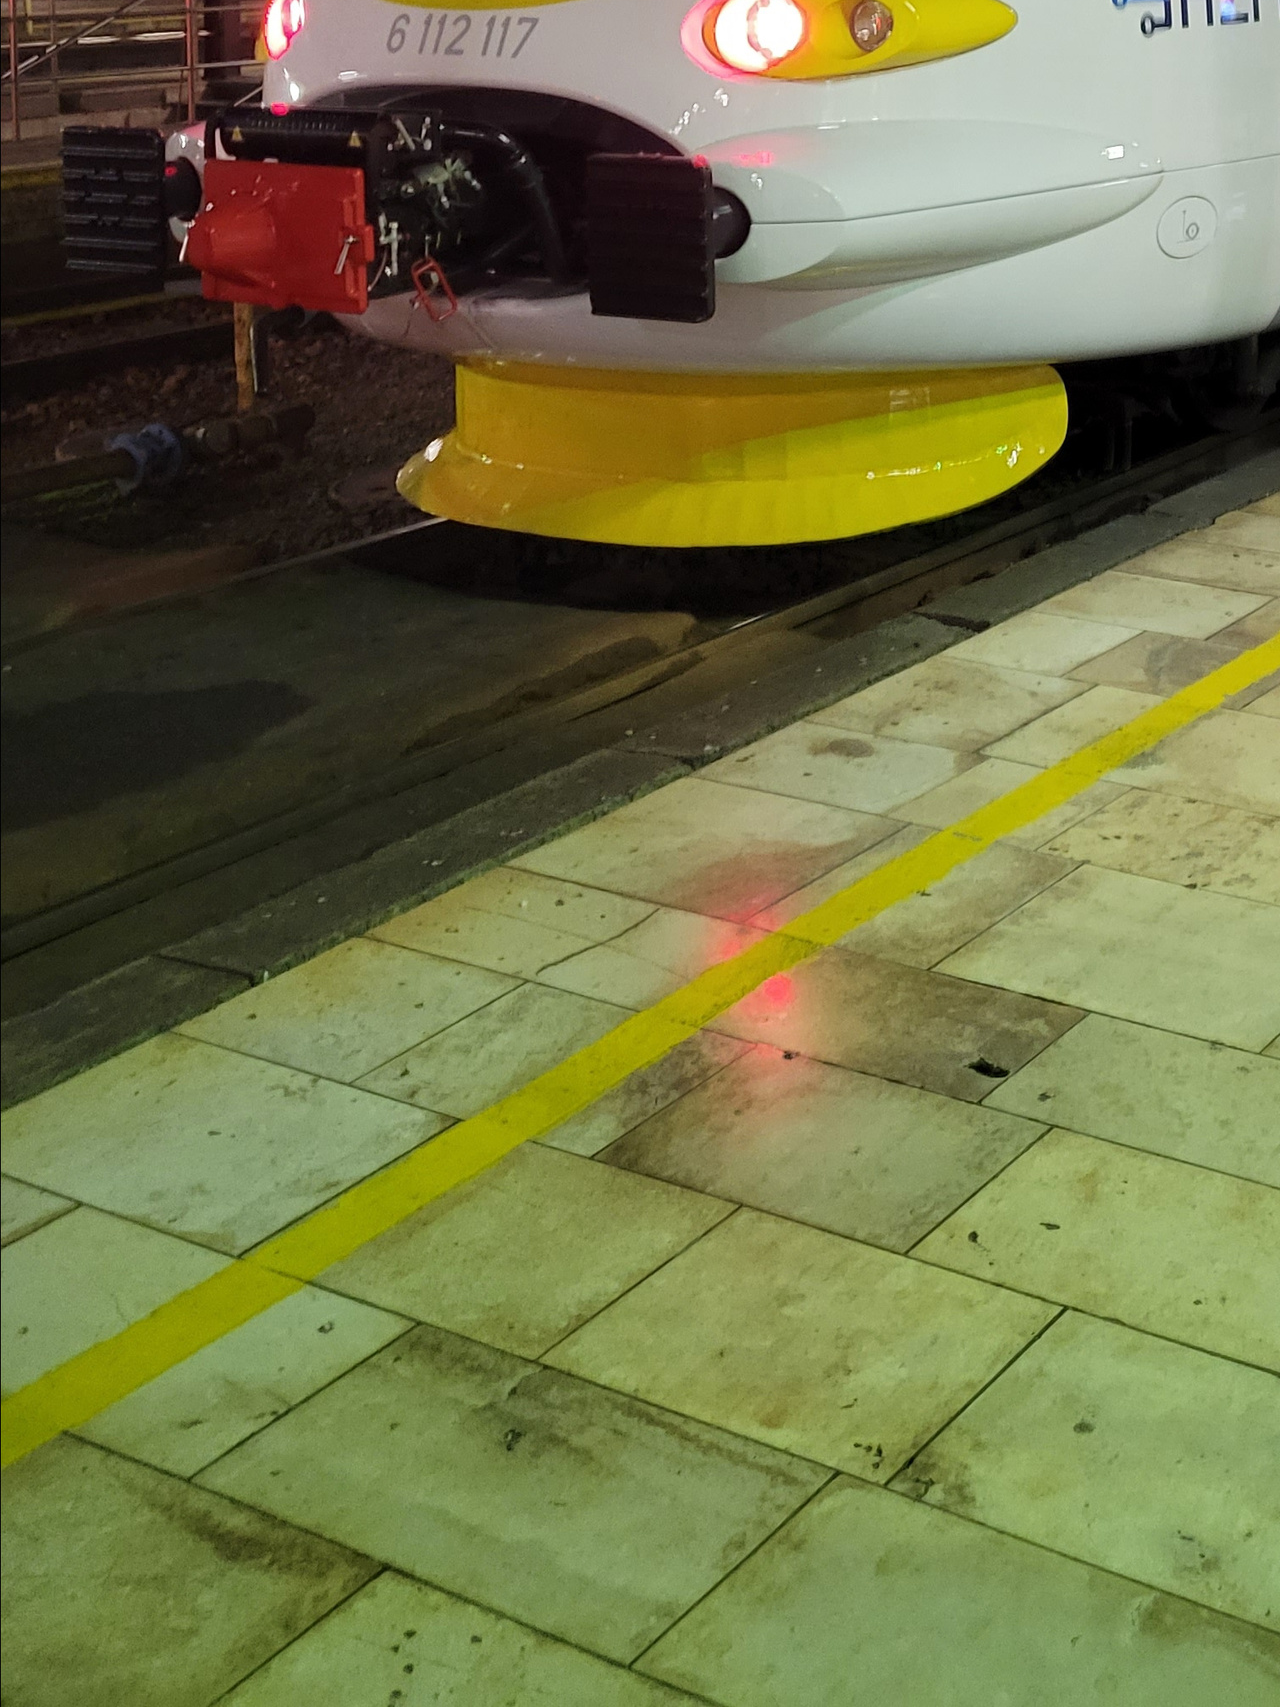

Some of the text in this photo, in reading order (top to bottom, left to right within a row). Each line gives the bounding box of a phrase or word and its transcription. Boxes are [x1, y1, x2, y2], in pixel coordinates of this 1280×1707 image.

[386, 13, 540, 59] 6 112 117
